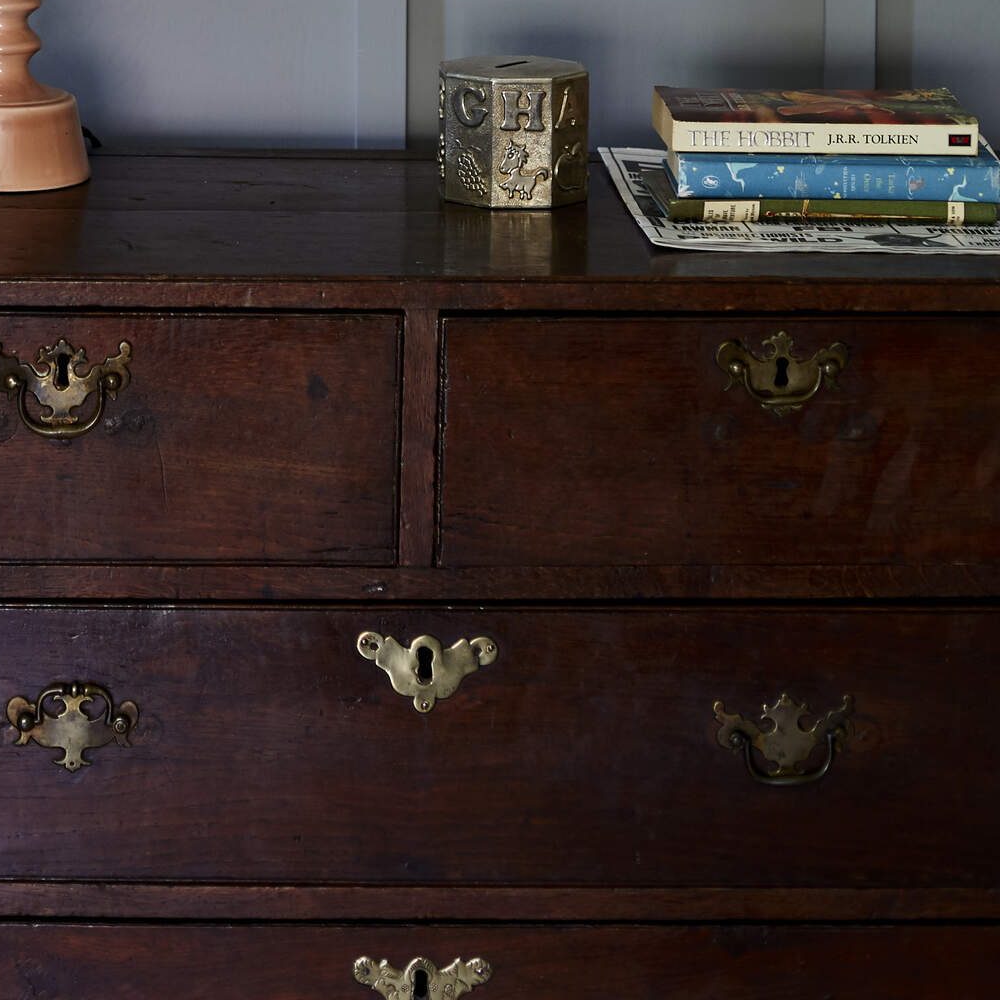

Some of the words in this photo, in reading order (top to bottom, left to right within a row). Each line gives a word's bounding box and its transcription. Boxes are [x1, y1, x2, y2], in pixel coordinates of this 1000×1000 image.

[453, 87, 488, 127] G
[500, 90, 546, 131] H
[687, 130, 731, 147] THE
[738, 130, 815, 148] HOBBIT
[827, 134, 860, 146] J.R.R.
[863, 134, 920, 145] TOLKIEN
